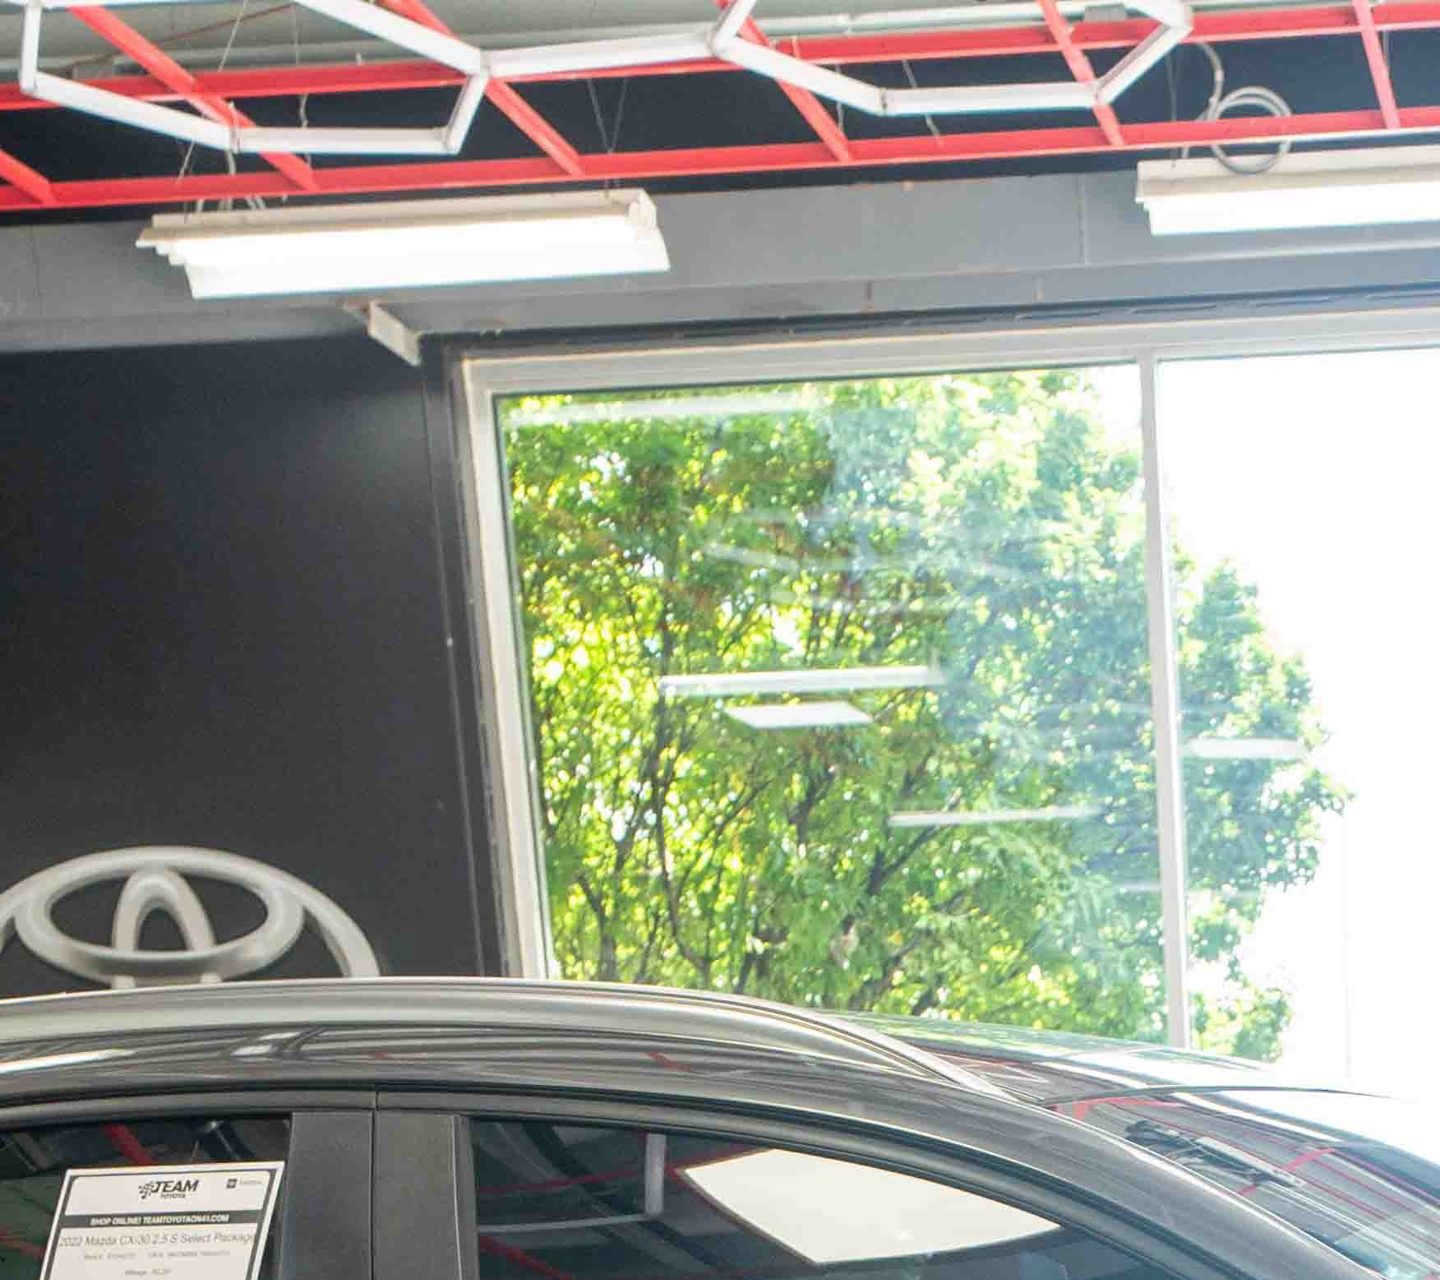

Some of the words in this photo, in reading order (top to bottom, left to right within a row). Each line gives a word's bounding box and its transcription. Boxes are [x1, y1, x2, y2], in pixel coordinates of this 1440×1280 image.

[152, 1180, 199, 1193] TEAM
[90, 1217, 111, 1226] SHOP
[85, 1236, 117, 1246] Mazda
[179, 1233, 212, 1244] Select
